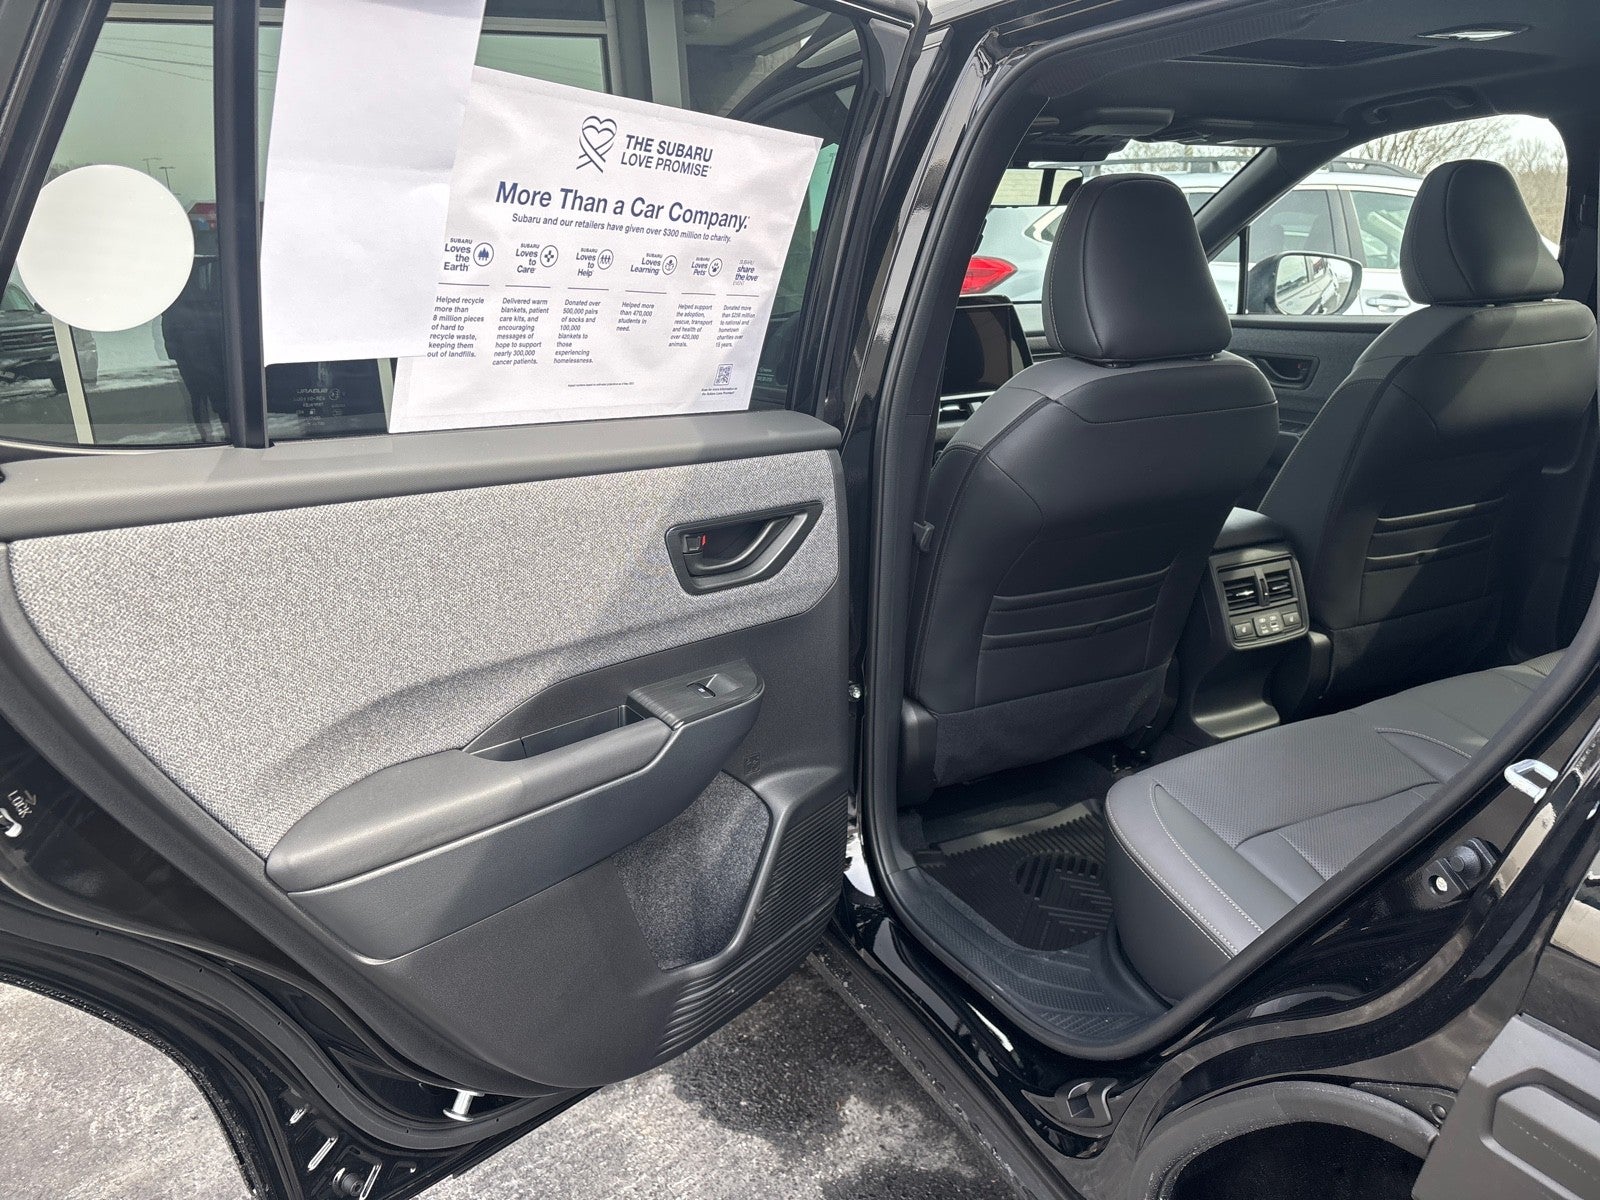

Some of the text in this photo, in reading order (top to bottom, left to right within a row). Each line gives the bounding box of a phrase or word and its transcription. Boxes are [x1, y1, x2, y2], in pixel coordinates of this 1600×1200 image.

[625, 134, 713, 162] THE SUBARU
[621, 152, 654, 168] LOVE
[495, 181, 552, 207] More
[559, 188, 607, 213] Than
[613, 200, 624, 215] a
[630, 197, 664, 219] Car
[512, 213, 731, 243] Subaru and our retailers have given over $300 million to charity.
[444, 243, 471, 253] Loves
[516, 249, 537, 257] Loves
[455, 254, 469, 262] the
[642, 258, 661, 266] Loves
[444, 262, 469, 272] Earth
[630, 265, 659, 275] Learning
[737, 265, 755, 273] share
[578, 269, 593, 278] Help
[8, 790, 32, 818] LOCK
